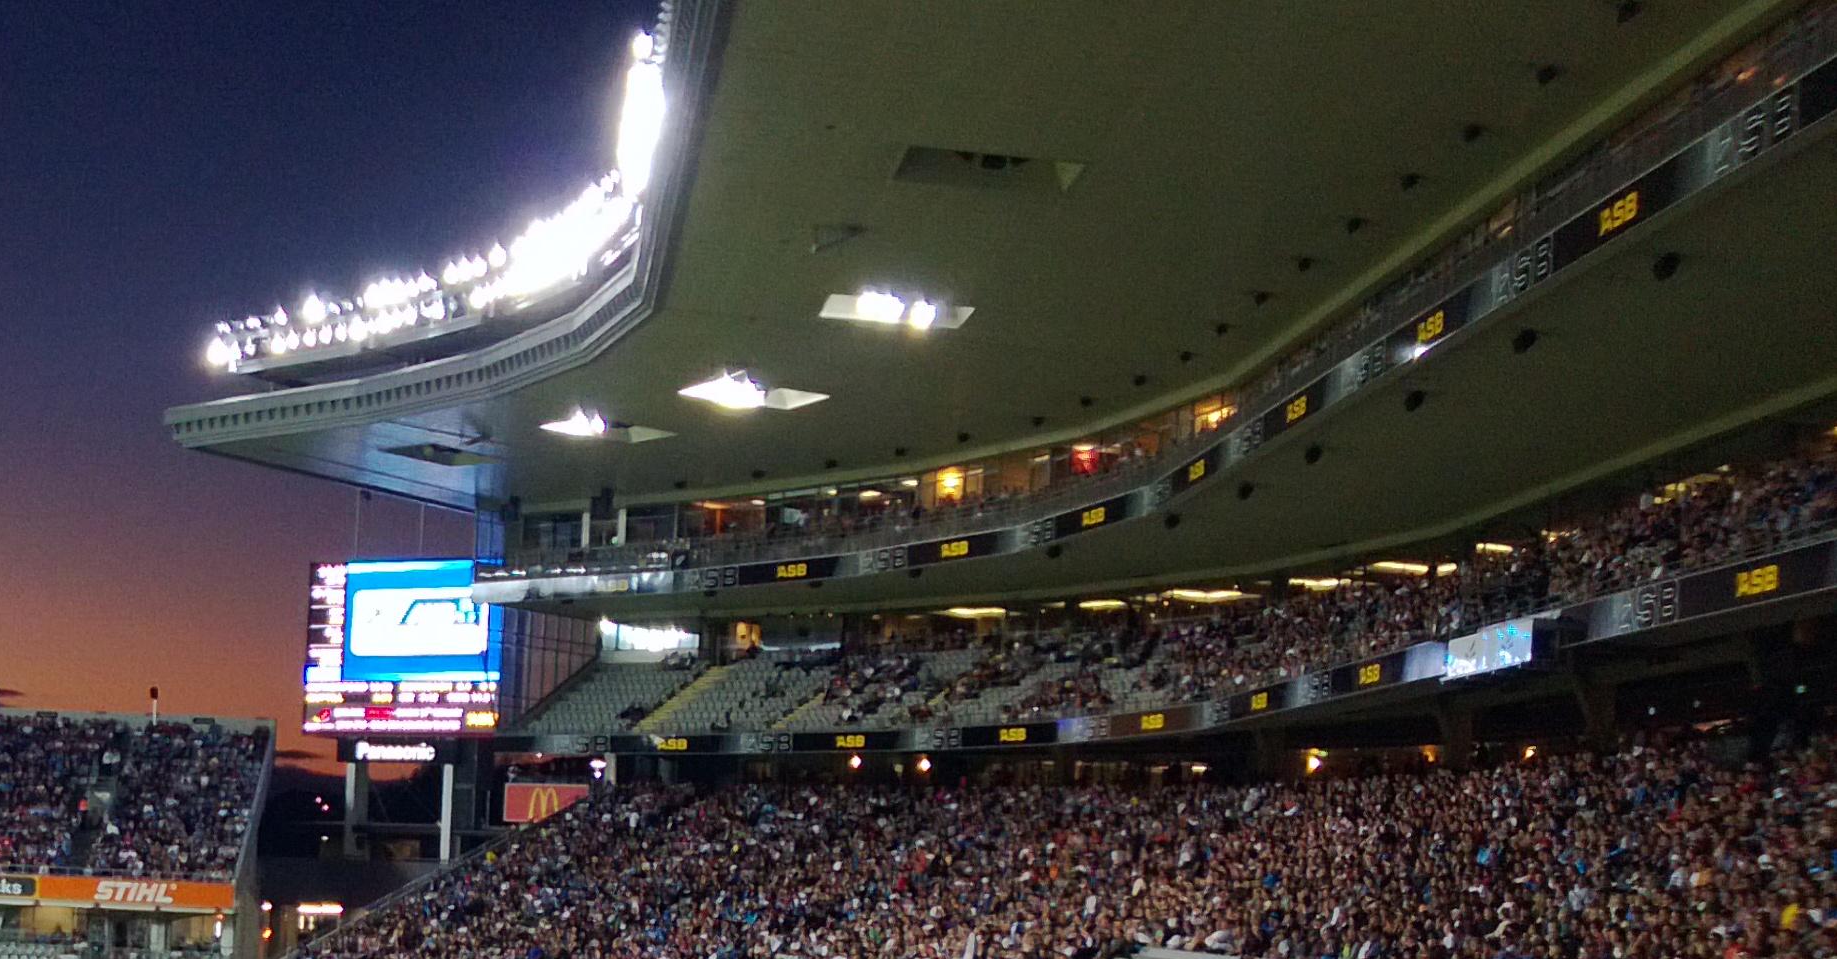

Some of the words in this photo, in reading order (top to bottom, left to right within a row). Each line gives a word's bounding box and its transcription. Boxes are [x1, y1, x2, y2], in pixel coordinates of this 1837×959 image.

[1599, 191, 1639, 237] ASB
[1417, 310, 1443, 345] ASB
[940, 540, 969, 557] ASB
[777, 564, 807, 579] ASB
[1735, 564, 1780, 598] ASB
[657, 737, 688, 751] ASB
[836, 734, 865, 749] ASB
[1000, 727, 1027, 742] ASB
[355, 740, 436, 761] Panasonic
[94, 881, 175, 903] STIHL
